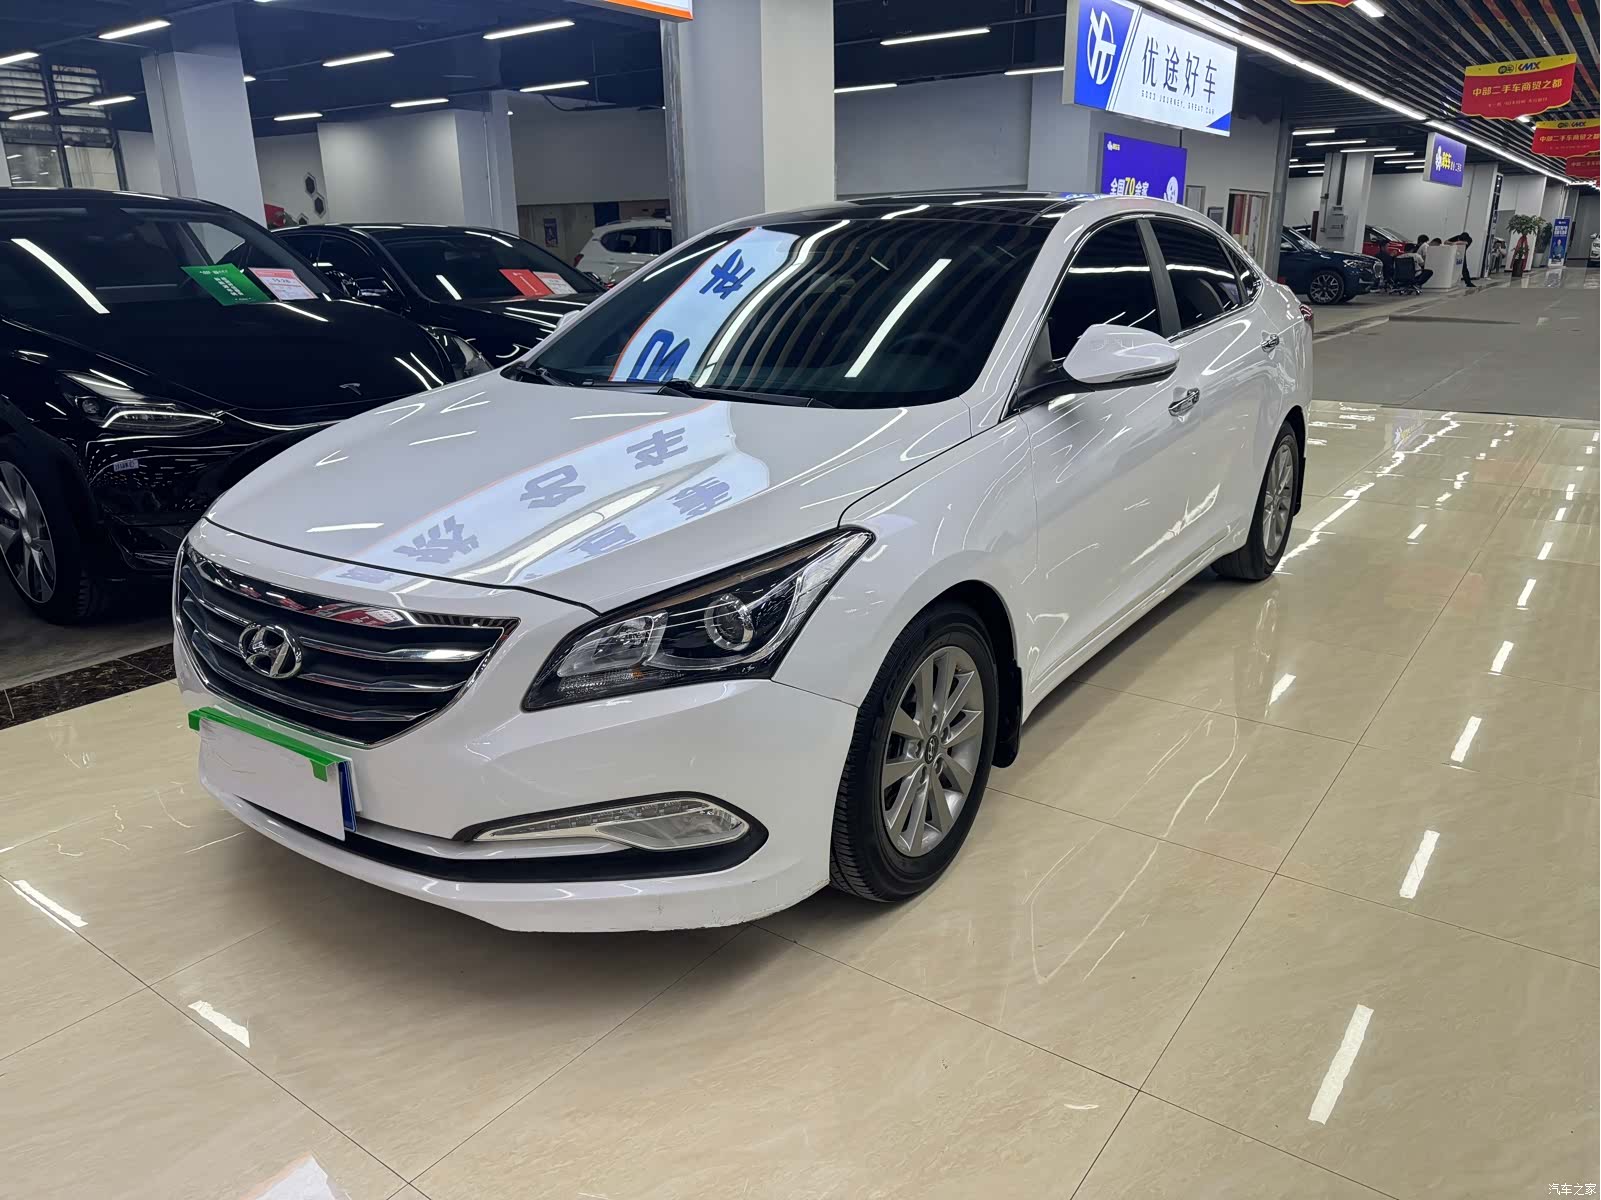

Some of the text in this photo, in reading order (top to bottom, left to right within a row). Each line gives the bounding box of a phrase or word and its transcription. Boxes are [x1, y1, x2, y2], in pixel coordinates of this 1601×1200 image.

[1141, 35, 1218, 103] 优途好车
[1472, 78, 1563, 97] 中部二手车商贸之都
